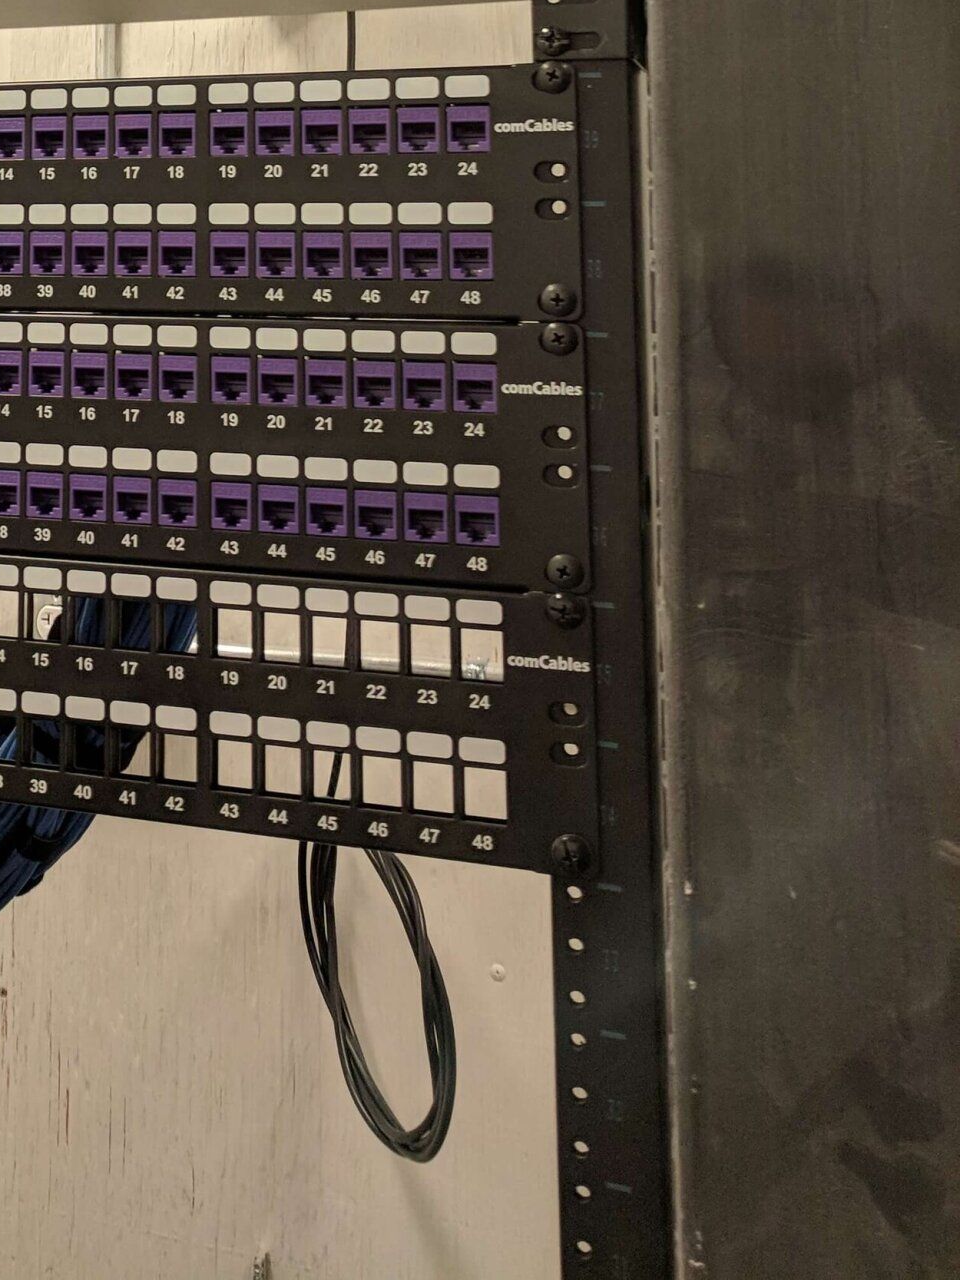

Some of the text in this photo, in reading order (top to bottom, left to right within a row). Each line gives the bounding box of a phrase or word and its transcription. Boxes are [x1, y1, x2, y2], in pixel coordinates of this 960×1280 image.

[493, 117, 575, 133] comCables
[38, 167, 56, 180] 15
[80, 166, 98, 180] 16
[123, 166, 141, 179] 17
[167, 165, 185, 179] 18
[218, 164, 237, 179] 19
[263, 164, 283, 178] 20
[310, 163, 329, 178] 21
[358, 163, 379, 177] 22
[407, 162, 428, 177] 23
[457, 161, 479, 176] 24
[36, 284, 54, 298] 39
[78, 284, 97, 299] 40
[122, 285, 139, 299] 41
[165, 286, 185, 300] 42
[218, 286, 238, 301] 43
[264, 287, 285, 302] 44
[312, 288, 332, 303] 45
[360, 289, 381, 304] 46
[409, 289, 431, 304] 47
[459, 290, 481, 305] 48
[500, 380, 583, 397] comCables
[35, 404, 53, 419] 15
[78, 406, 96, 421] 16
[122, 408, 140, 423] 17
[167, 410, 186, 425] 18
[220, 412, 239, 427] 19
[266, 414, 286, 429] 20
[314, 416, 333, 431] 21
[363, 418, 384, 433] 22
[413, 420, 434, 435] 23
[463, 422, 485, 437] 24
[33, 527, 51, 542] 39
[76, 530, 95, 545] 40
[120, 533, 138, 548] 41
[166, 536, 185, 552] 42
[219, 540, 240, 555] 43
[267, 543, 288, 559] 44
[315, 546, 336, 562] 45
[364, 549, 385, 565] 46
[414, 552, 436, 568] 47
[466, 556, 488, 572] 48
[506, 654, 591, 673] comCables
[31, 652, 50, 667] 15
[75, 656, 94, 672] 16
[120, 660, 139, 676] 17
[166, 664, 185, 681] 18
[220, 670, 239, 686] 19
[267, 674, 287, 690] 20
[316, 679, 335, 695] 21
[365, 683, 387, 700] 22
[416, 688, 438, 705] 23
[468, 693, 491, 710] 24
[29, 778, 48, 794] 39
[73, 784, 93, 800] 40
[118, 790, 136, 806] 41
[164, 795, 184, 812] 42
[219, 802, 240, 819] 43
[267, 808, 289, 825] 44
[317, 814, 338, 831] 45
[367, 821, 389, 838] 46
[419, 827, 441, 844] 47
[471, 834, 494, 851] 48
